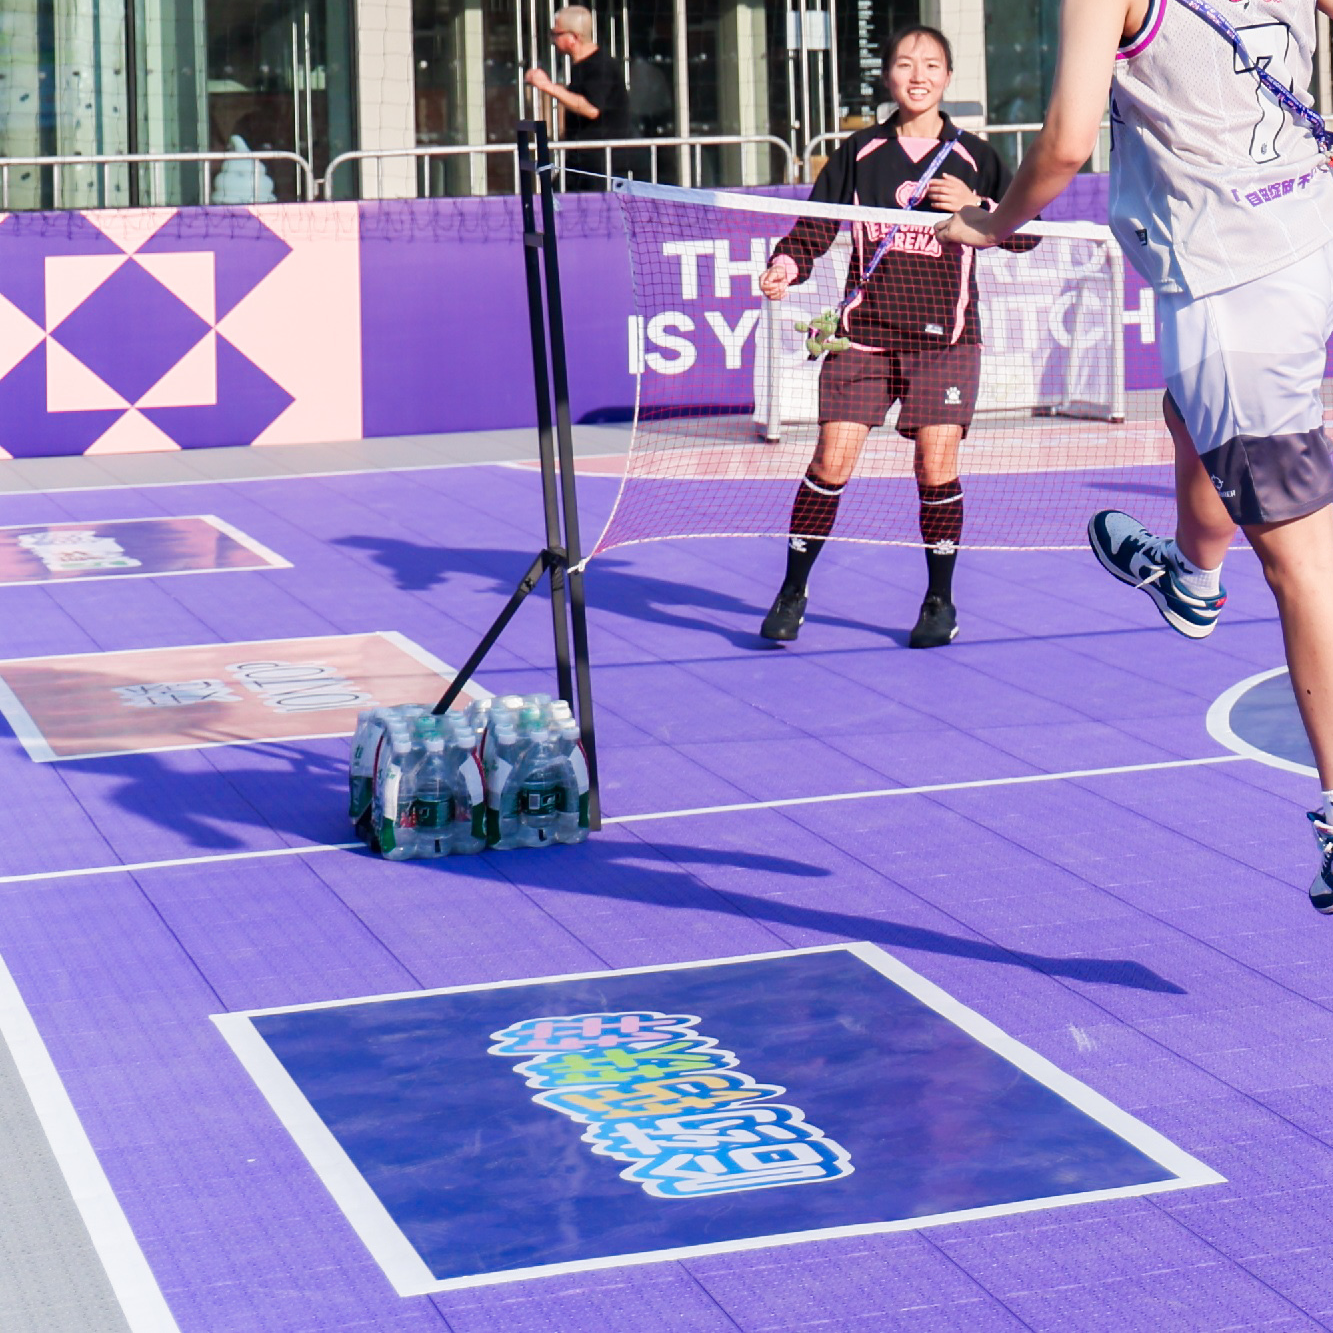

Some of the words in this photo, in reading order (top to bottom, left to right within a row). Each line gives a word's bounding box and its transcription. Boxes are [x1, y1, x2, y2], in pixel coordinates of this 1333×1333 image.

[890, 232, 939, 254] RENA
[628, 310, 698, 374] IS
[978, 288, 1156, 353] ITCH
[500, 1013, 838, 1195] 哈药钙铁锌
